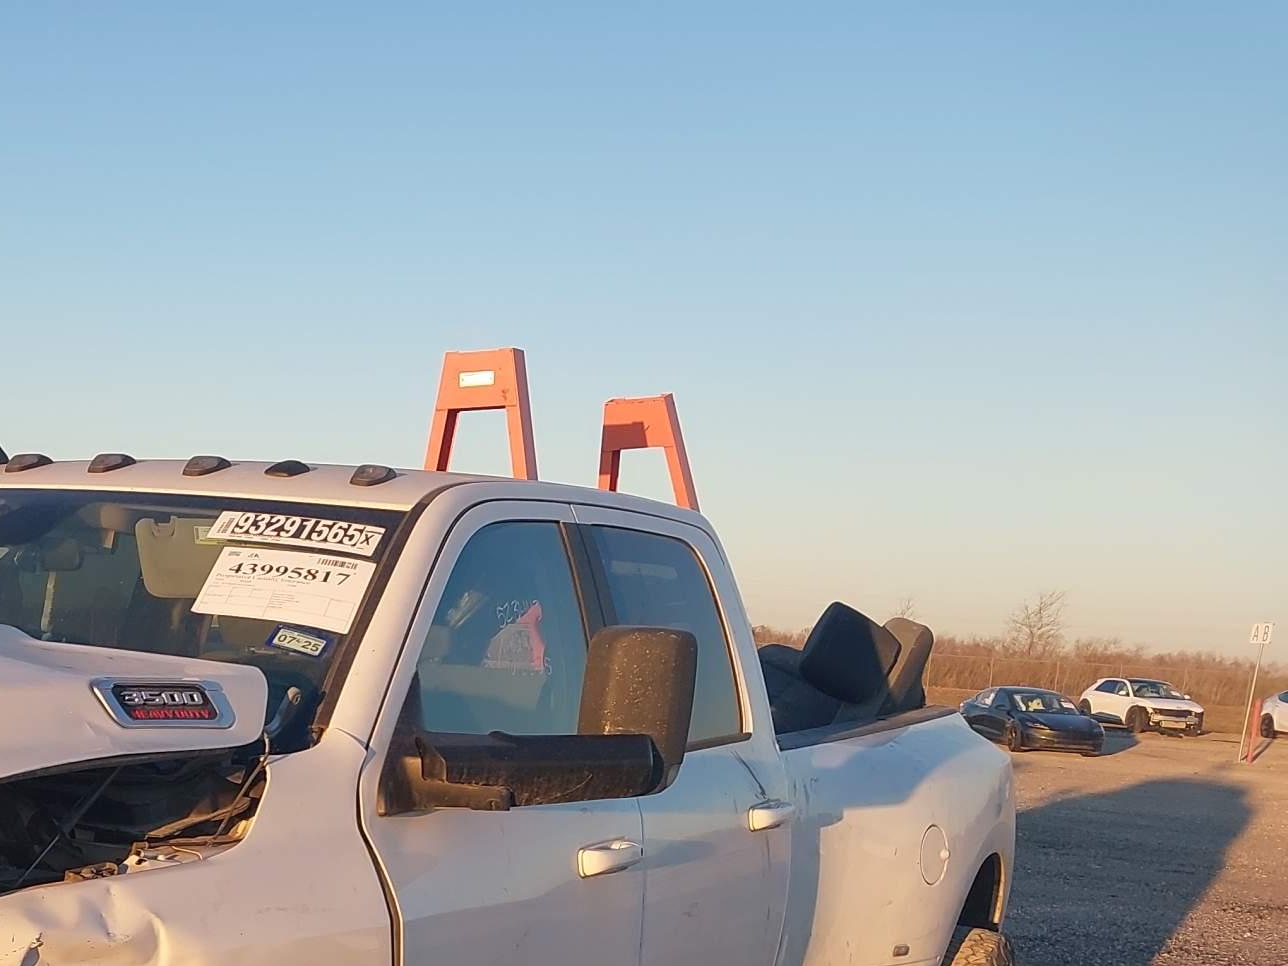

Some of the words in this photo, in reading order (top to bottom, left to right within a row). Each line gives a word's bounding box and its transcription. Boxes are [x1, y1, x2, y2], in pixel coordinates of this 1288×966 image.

[234, 512, 365, 546] 93291565
[360, 533, 375, 546] X
[229, 562, 351, 586] 43995817
[278, 633, 297, 645] 07
[301, 640, 321, 652] 25
[120, 691, 203, 705] 3500
